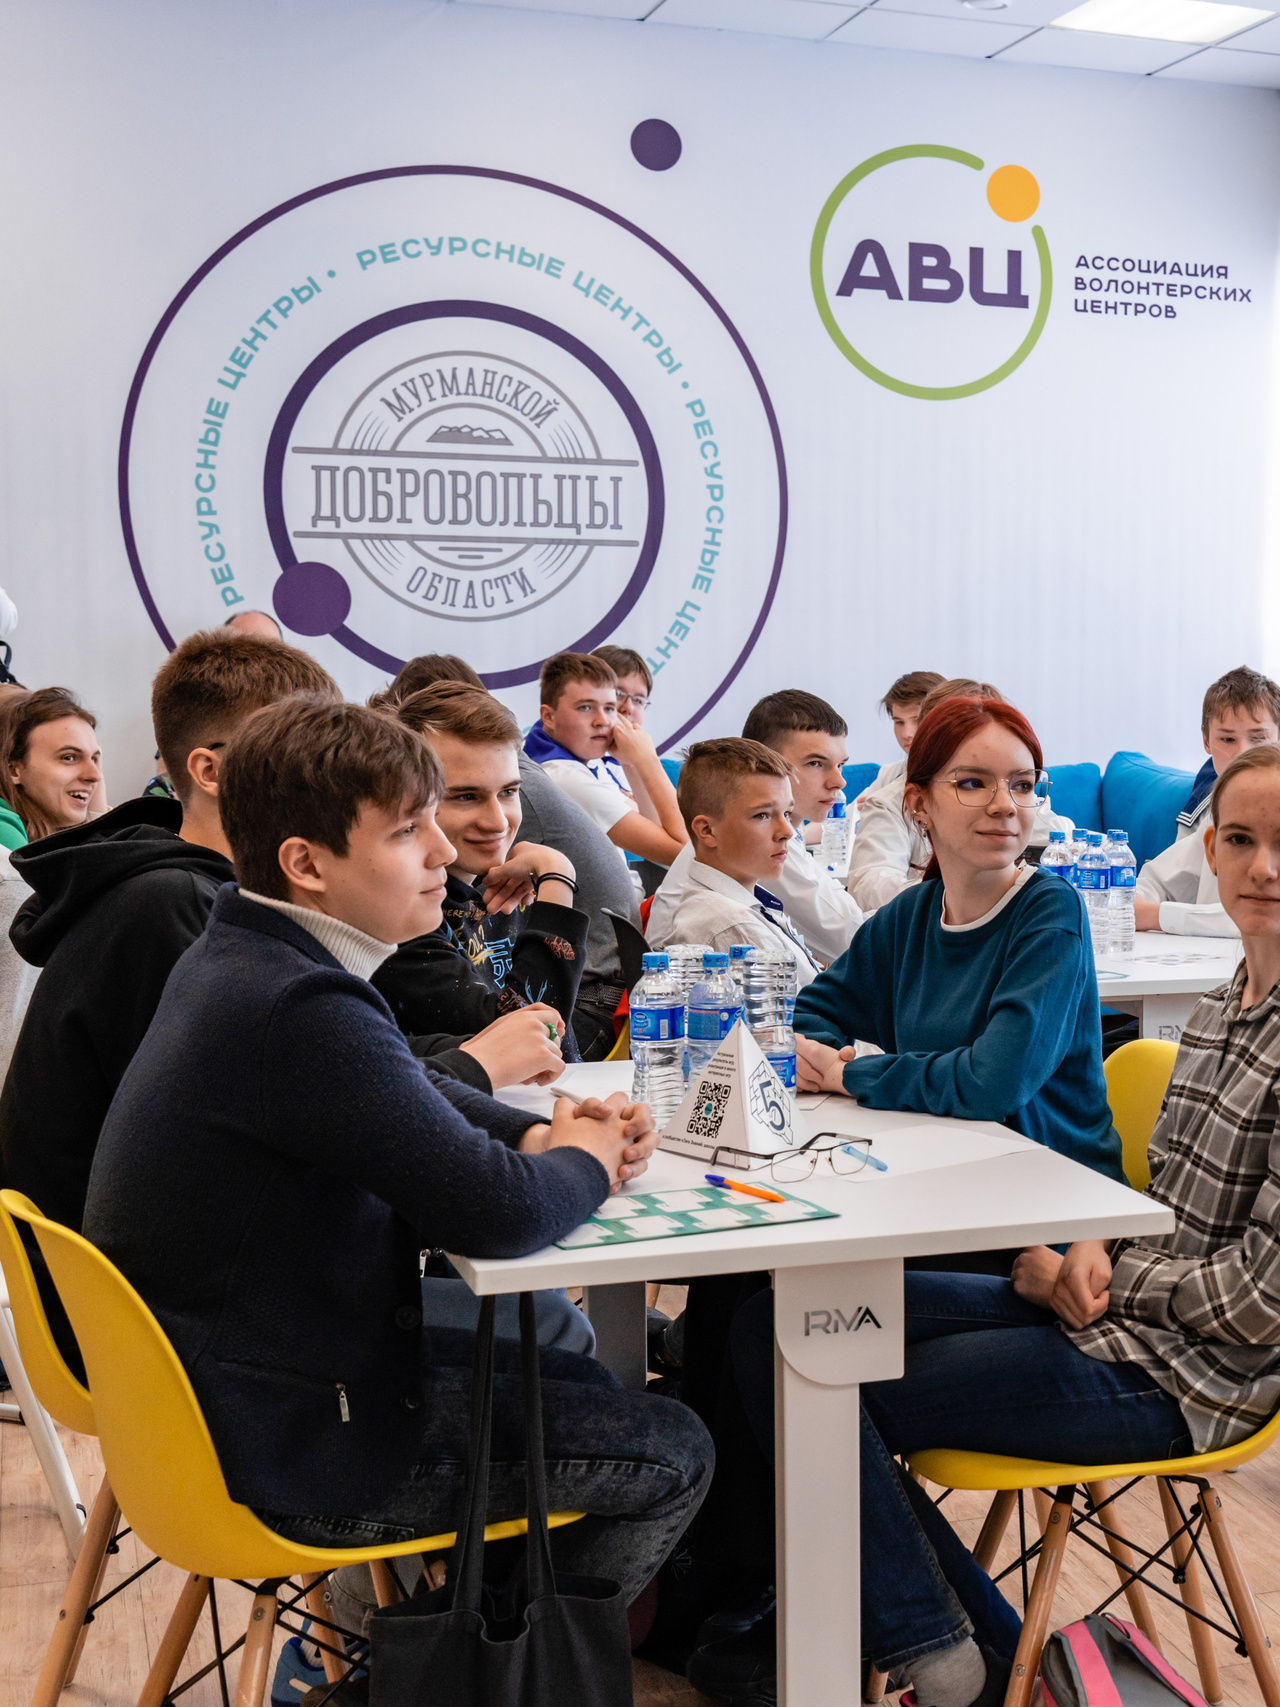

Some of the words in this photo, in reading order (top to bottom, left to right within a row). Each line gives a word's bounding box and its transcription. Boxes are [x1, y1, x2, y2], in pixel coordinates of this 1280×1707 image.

[834, 238, 1030, 309] АВЦ
[1073, 276, 1253, 303] ВОЛОНТЕРСКИХ
[1075, 254, 1229, 280] АССОЦИАЦИЯ
[216, 275, 323, 391] ЦЕНТРЫ
[355, 236, 566, 271] РЕСУРСНЫЕ
[571, 270, 684, 376] ЦЕНТРЫ
[1073, 298, 1178, 319] ЦЕНТРОВ
[379, 366, 560, 429] МУРМАНСКОЙ
[194, 396, 246, 608] РЕСУРСНЫЕ
[310, 464, 623, 535] ДОБРОВОЛЬЦЫ
[684, 397, 725, 594] РЕСУРСНЫЕ
[405, 566, 537, 609] ОБЛАСТИ
[645, 600, 702, 676] ЦЕНТ
[759, 1080, 786, 1131] 5
